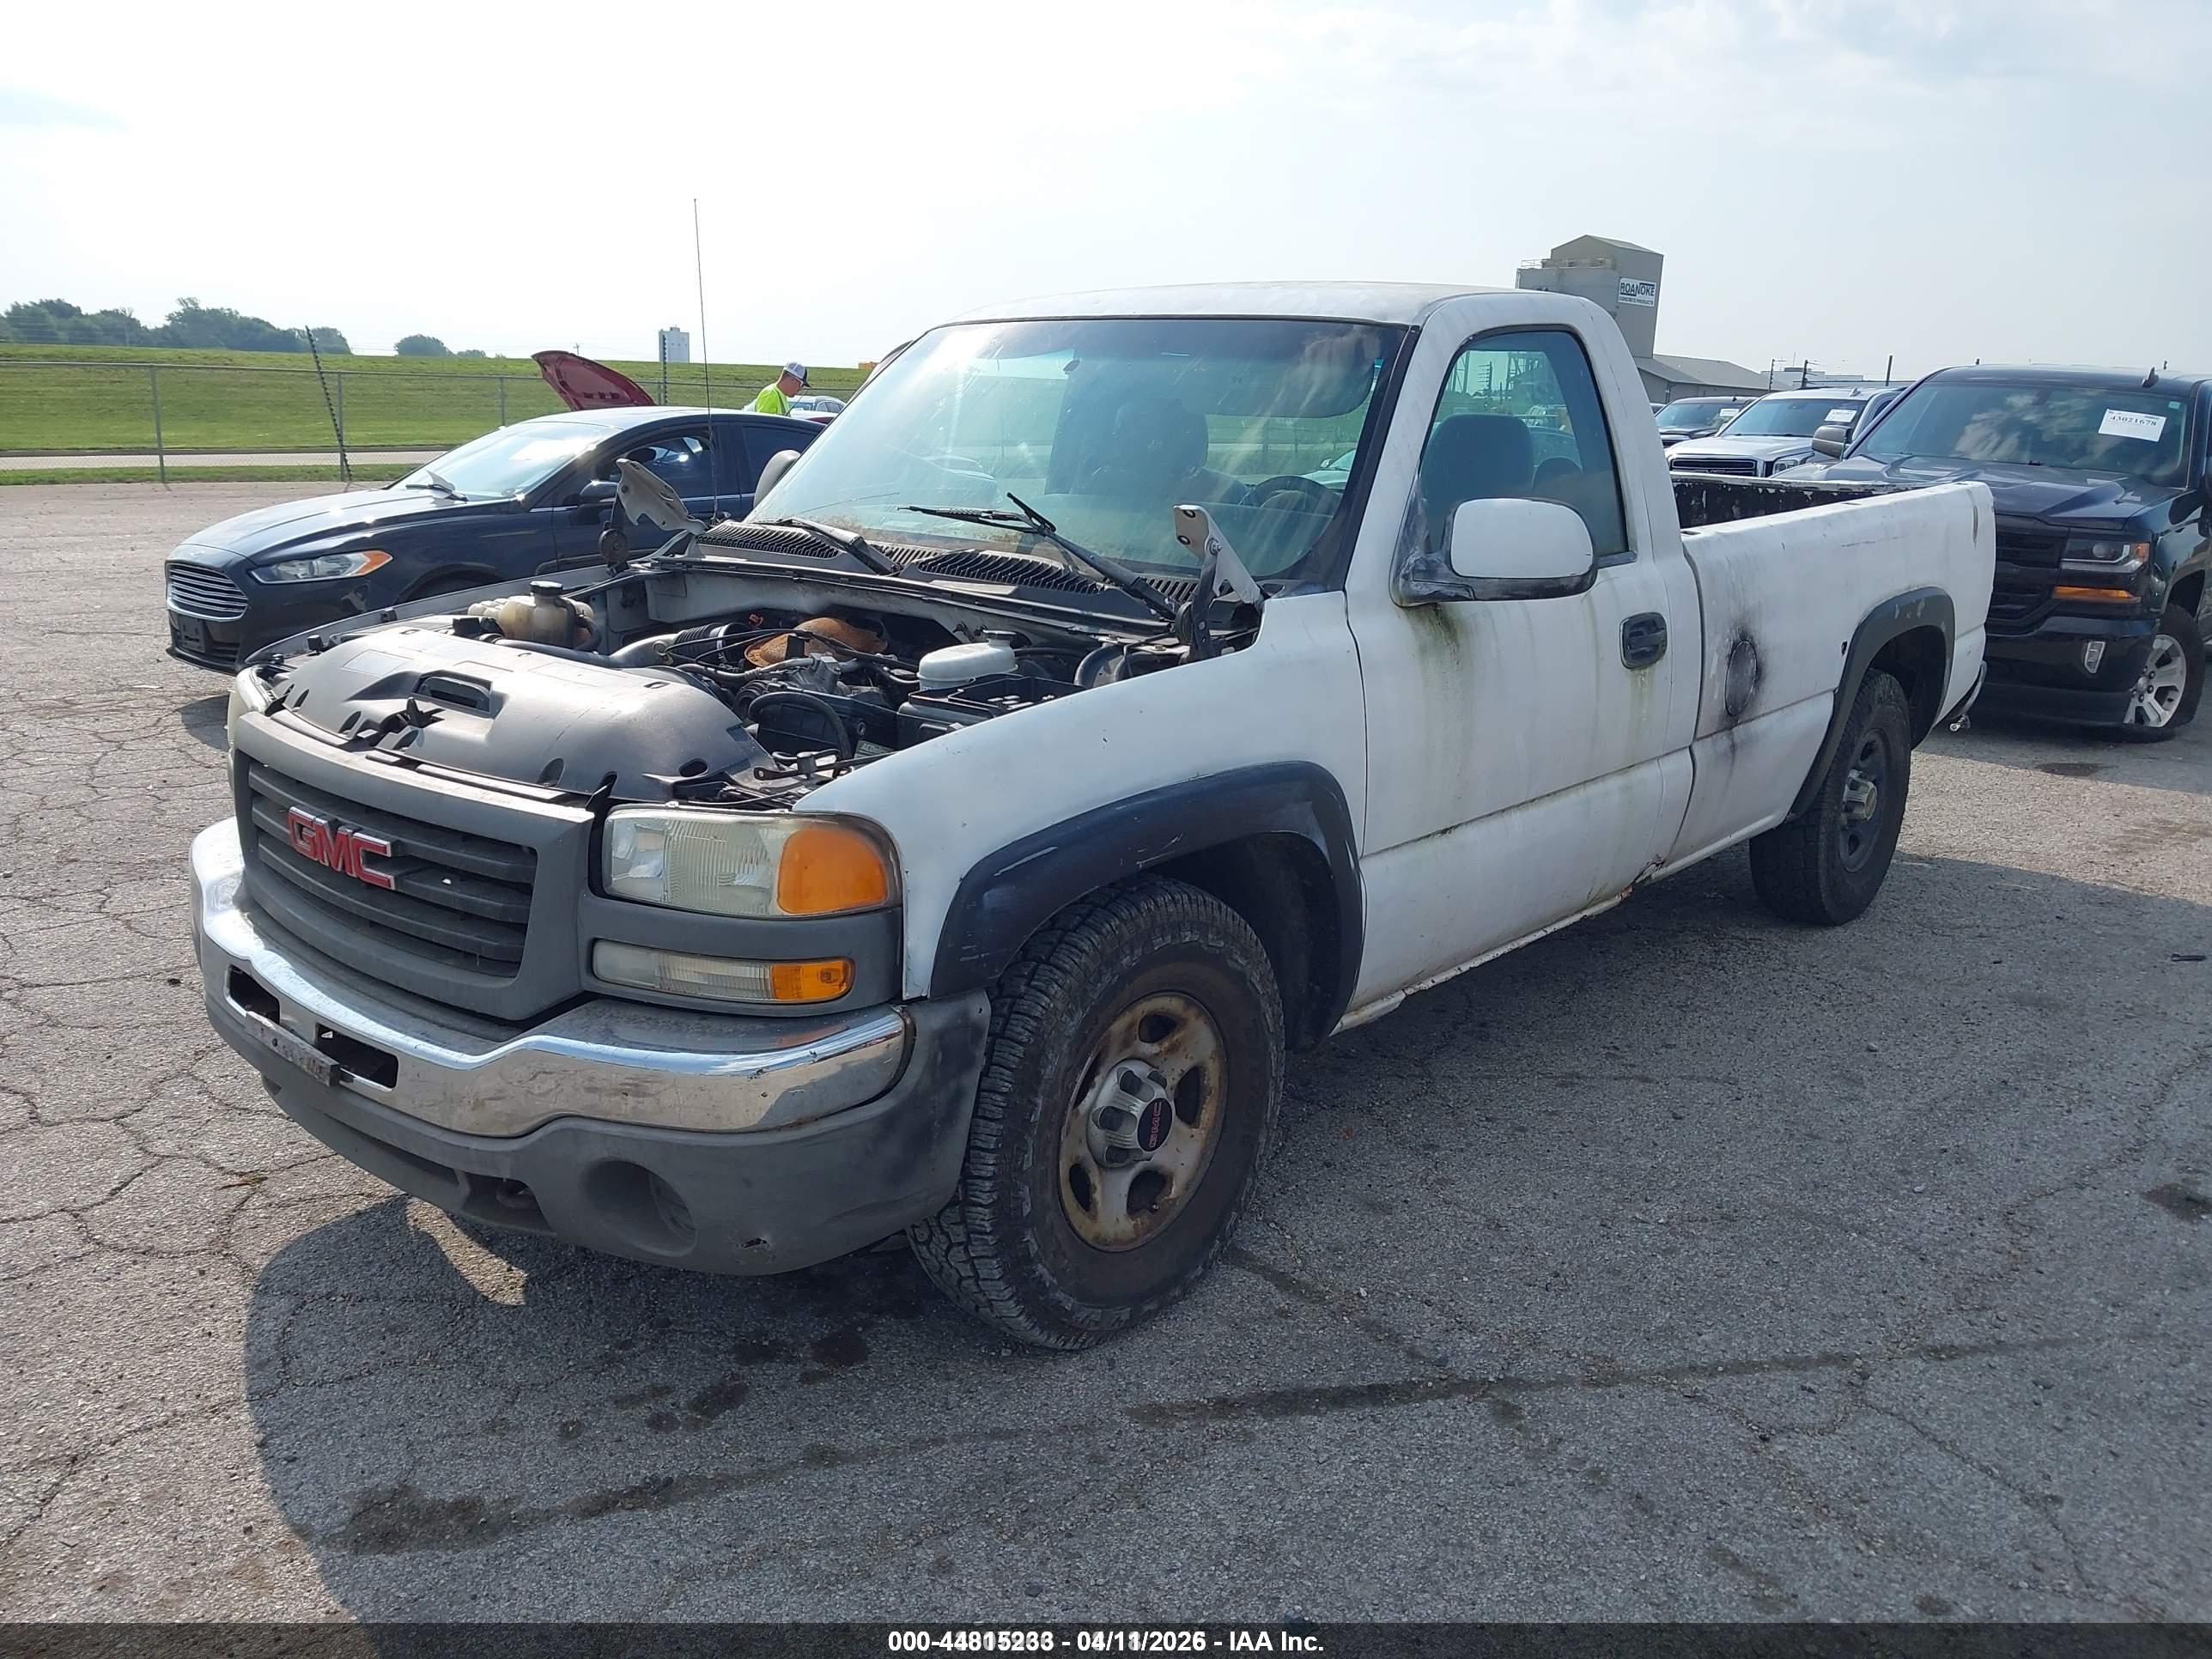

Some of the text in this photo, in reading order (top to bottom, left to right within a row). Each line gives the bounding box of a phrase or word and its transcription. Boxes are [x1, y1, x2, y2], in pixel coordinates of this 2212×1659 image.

[1620, 283, 1655, 296] ROANOKE
[289, 806, 395, 890] GMC
[1148, 1102, 1162, 1147] GMC
